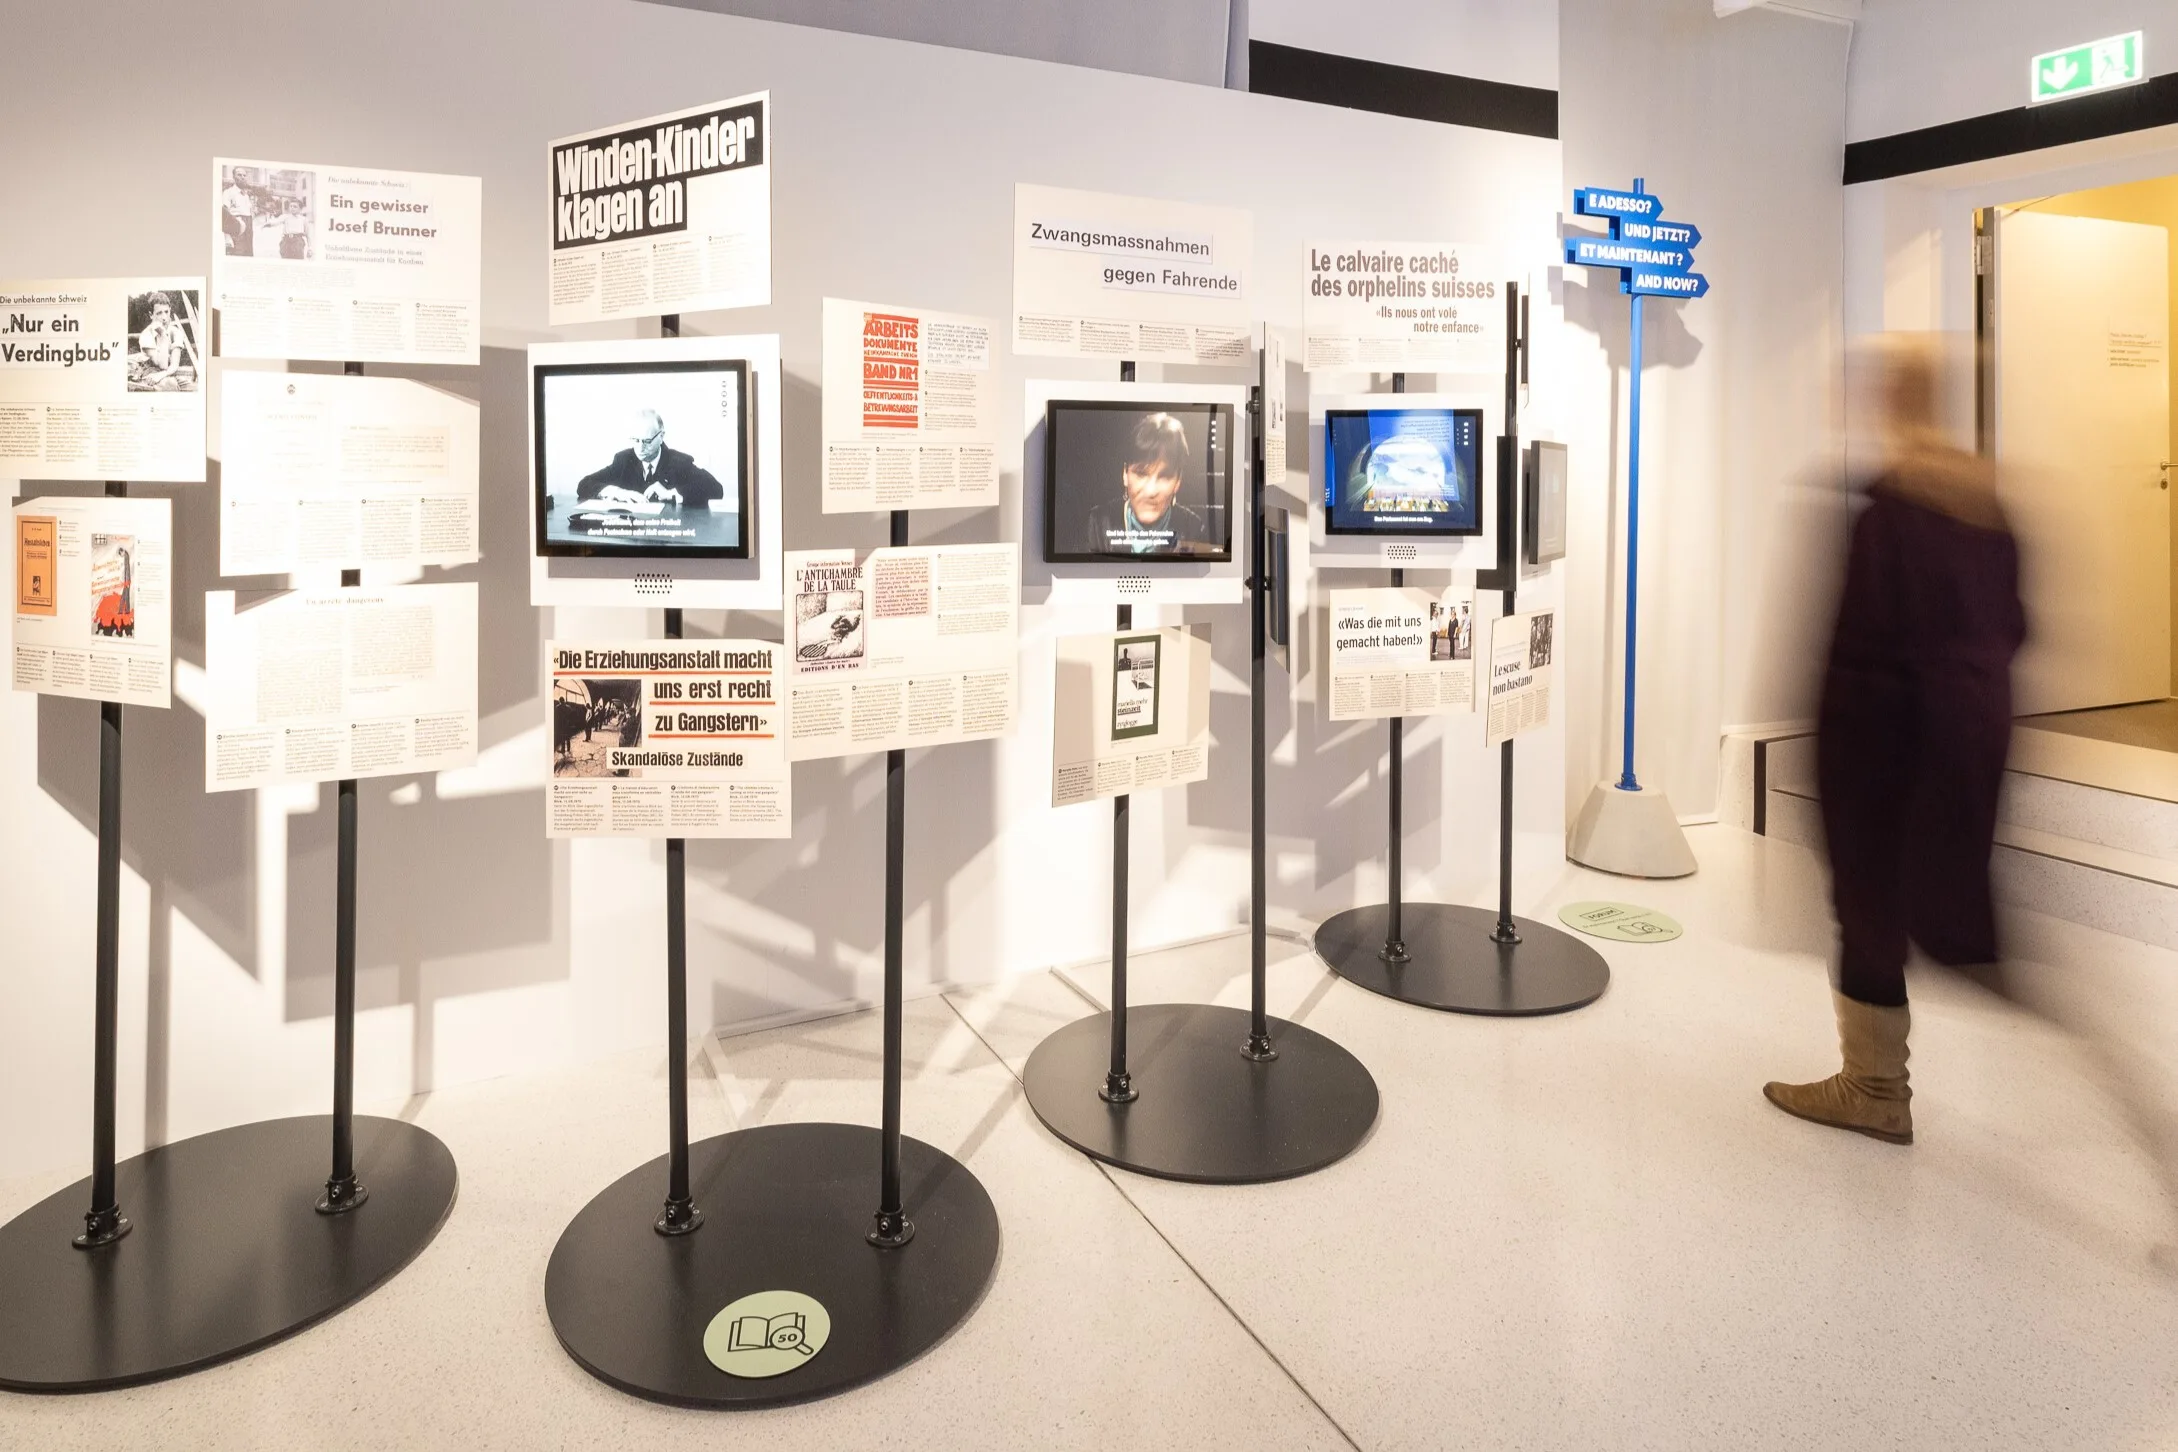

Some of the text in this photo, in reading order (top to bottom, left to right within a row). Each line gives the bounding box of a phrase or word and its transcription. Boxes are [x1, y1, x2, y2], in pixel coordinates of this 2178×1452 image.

[557, 114, 755, 196] Winden-Kinder
[330, 194, 429, 214] Ein gewisser
[558, 179, 683, 243] klagen an
[1589, 194, 1652, 214] E ADESSO?
[328, 218, 437, 238] Josef Brunner
[1624, 223, 1691, 243] UND JETZT?
[1031, 222, 1210, 256] Zwangsmassnahmen
[1311, 249, 1459, 273] Le calvaire caché
[1580, 243, 1595, 257] ET
[1598, 245, 1676, 265] MAINTENANT
[1103, 267, 1238, 291] gegen Fahrende
[1311, 274, 1495, 302] des orphelins suisses
[1636, 274, 1699, 292] AND NOW?
[0, 294, 87, 305] Die unbekannte Schweiz
[1395, 308, 1418, 319] nous
[1420, 308, 1436, 319] ont
[1438, 306, 1457, 319] volé
[2, 314, 79, 336] „Nur ein
[863, 321, 918, 338] ARBEITS
[1413, 321, 1439, 333] notre
[863, 338, 917, 352] DOKUMENTE
[863, 363, 896, 379] BAND
[797, 567, 863, 581] L'ANTICHAMBRE
[804, 579, 856, 592] DE LA TAULE
[1338, 616, 1422, 630] «Was die mit uns
[1336, 634, 1423, 652] gemacht haben!»
[554, 650, 772, 671] «Die Erziehungsanstalt macht
[1503, 661, 1521, 675] scuse
[654, 679, 771, 699] uns erst recht
[1492, 674, 1533, 696] non bastano
[655, 712, 767, 732] zu Gangstern»
[612, 751, 743, 766] Skandalöse Zustände
[778, 1333, 798, 1343] 50
